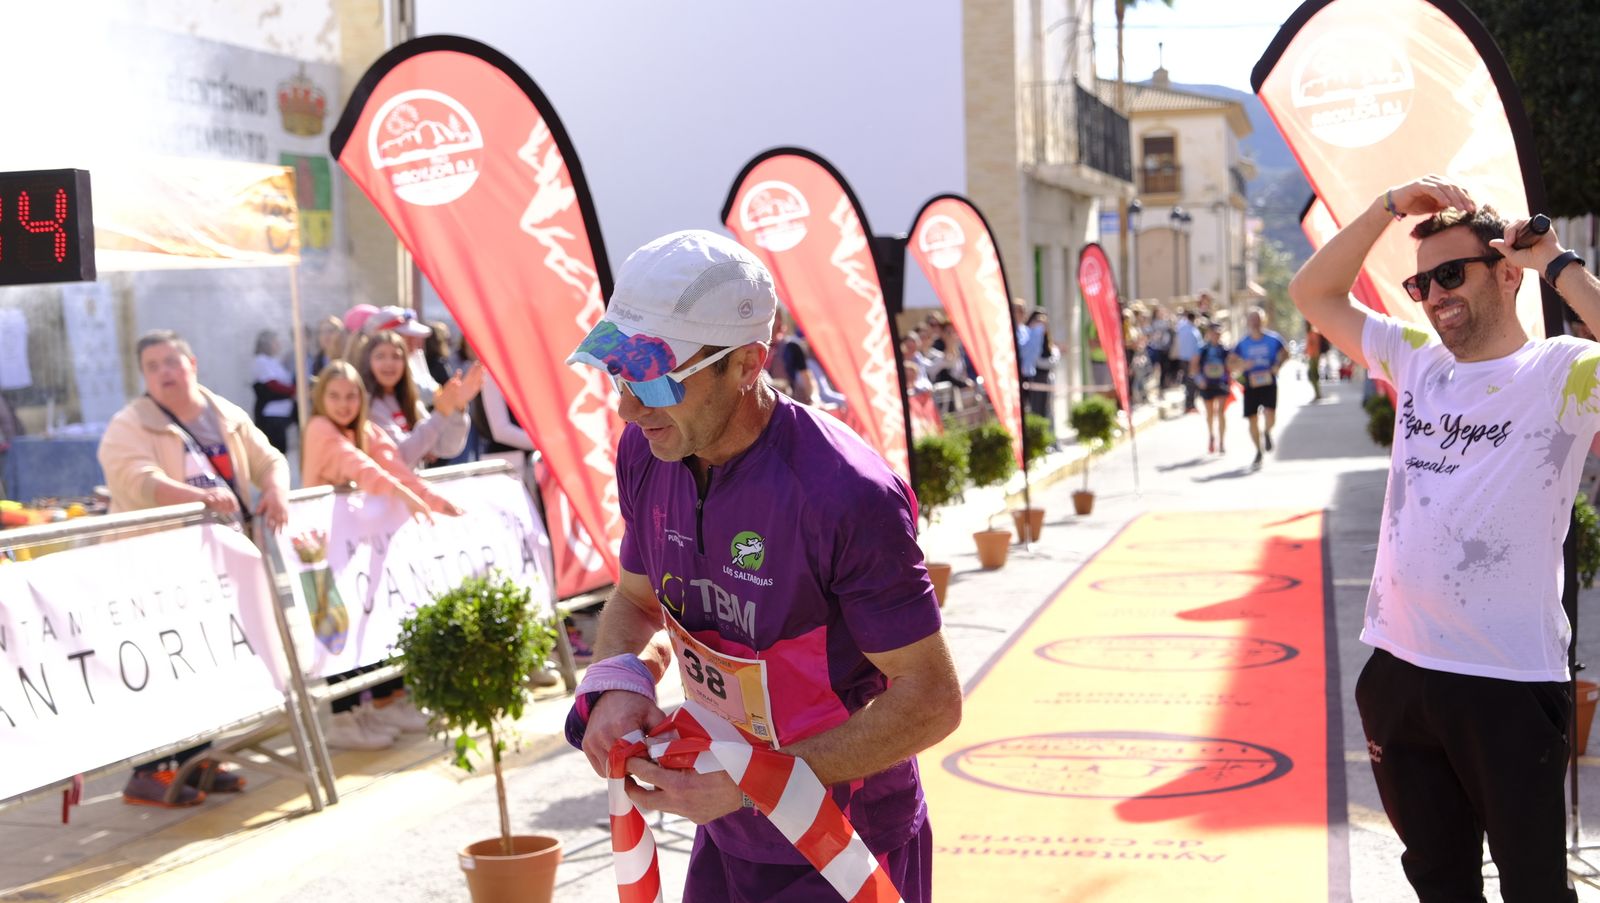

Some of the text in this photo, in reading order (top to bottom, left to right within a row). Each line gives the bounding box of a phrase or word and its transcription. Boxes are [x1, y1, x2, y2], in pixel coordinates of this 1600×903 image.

[1440, 413, 1513, 456] Yepes
[722, 565, 774, 587] LOS SALTABOJAS
[689, 578, 756, 640] TBM
[683, 647, 727, 700] 38
